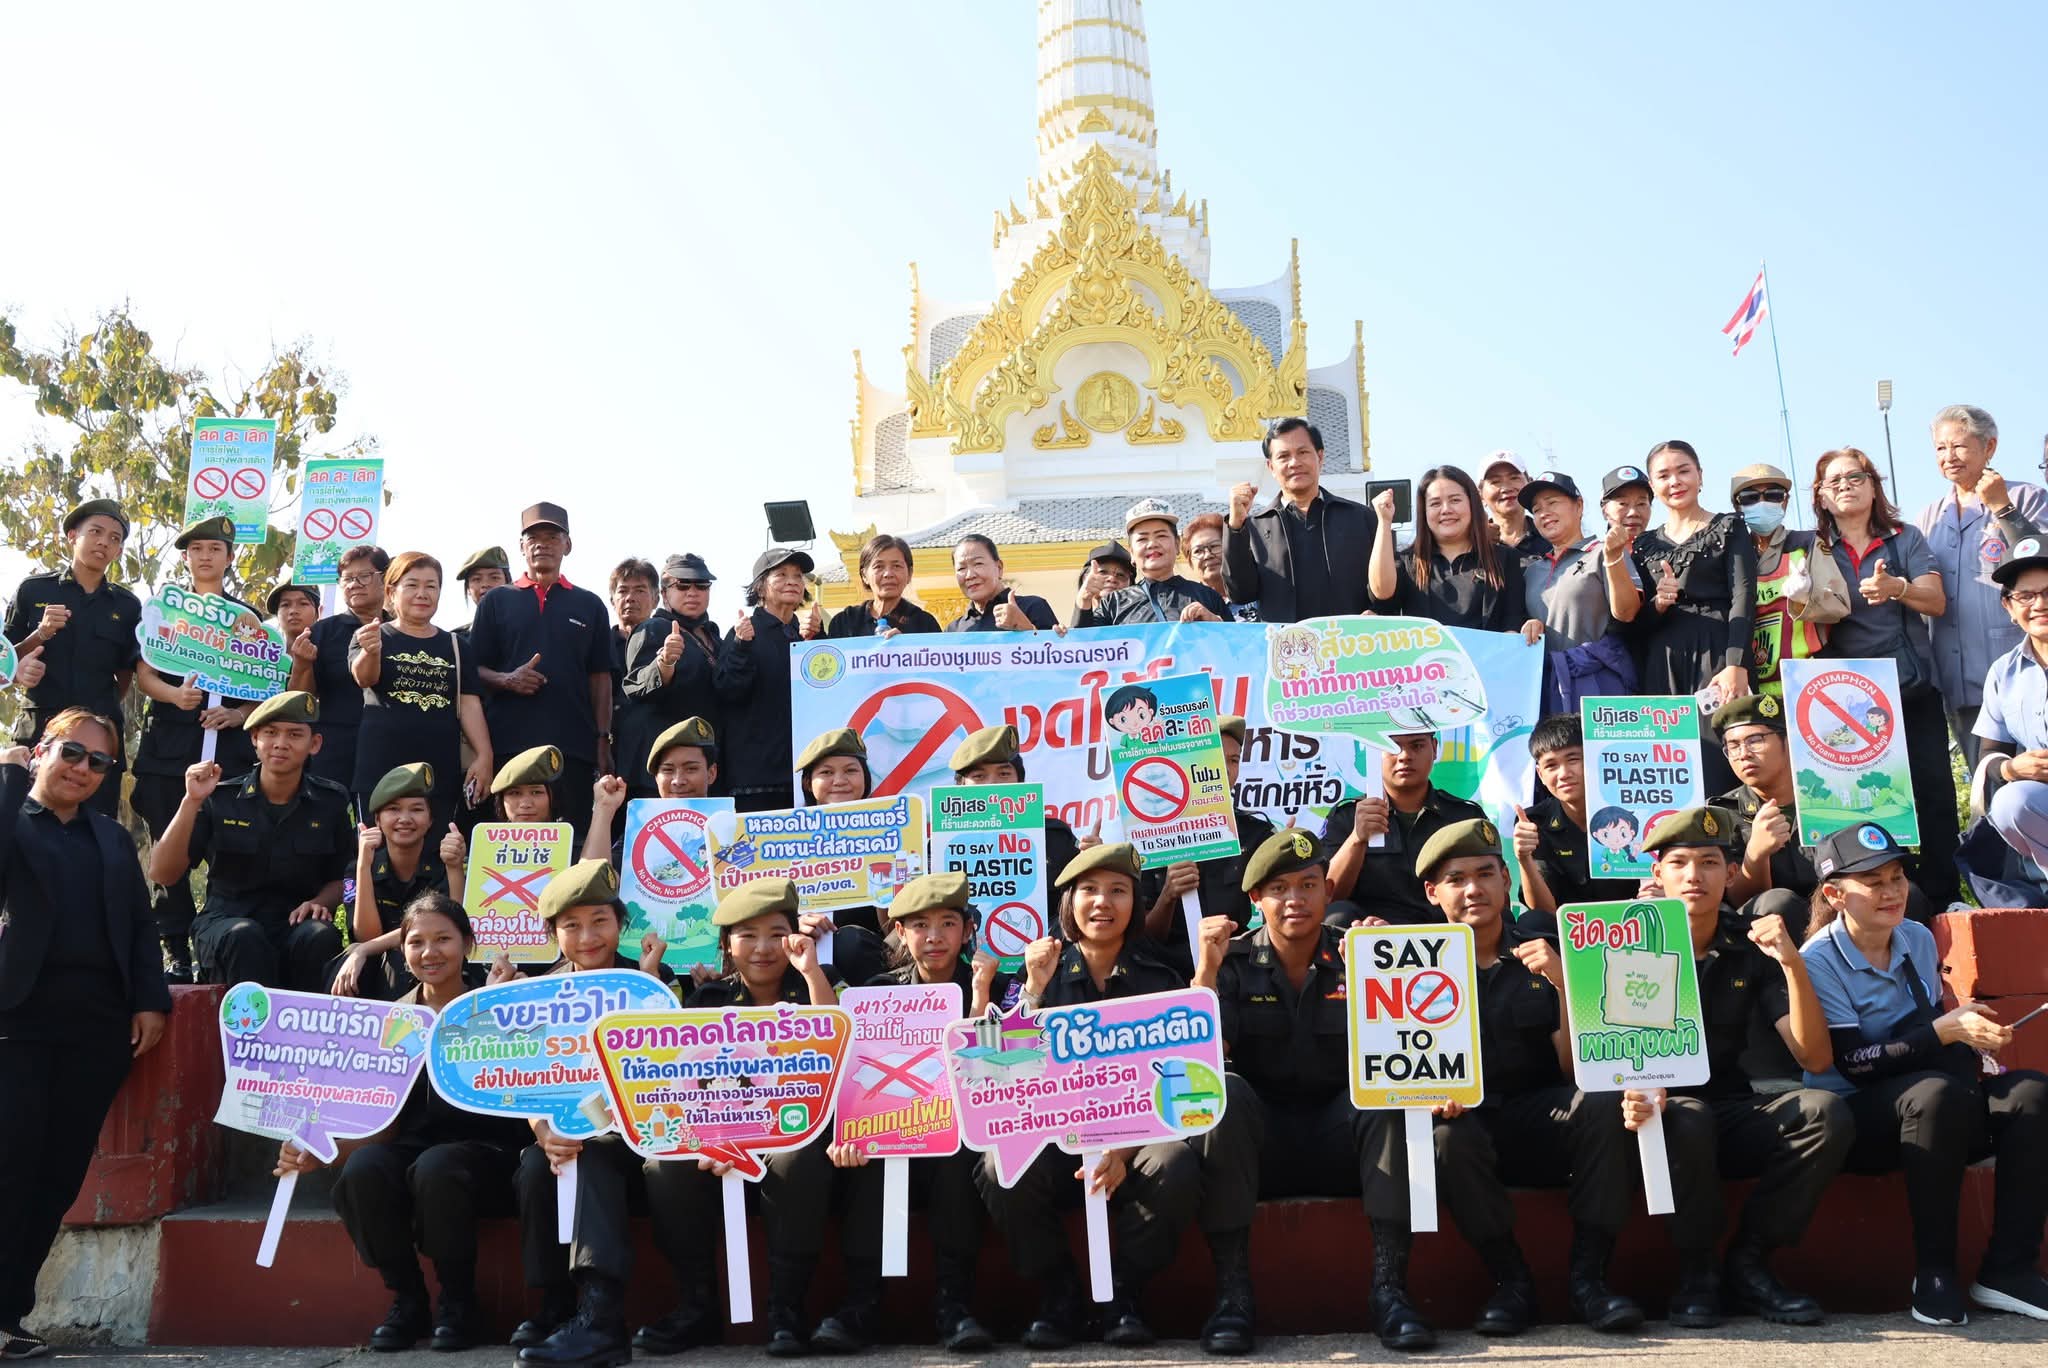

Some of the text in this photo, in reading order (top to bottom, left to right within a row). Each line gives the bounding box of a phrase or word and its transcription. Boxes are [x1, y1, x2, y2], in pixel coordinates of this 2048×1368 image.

[164, 588, 236, 627] ลดรับ
[175, 619, 228, 652] ลดให้
[230, 637, 282, 663] ลดใช้
[1319, 621, 1442, 660] สั่งอาหาร
[218, 655, 289, 684] พลาสติก
[851, 642, 1129, 672] เทศบาลเมืองชุมพร ร่วมใจรณรงค์
[1281, 662, 1446, 699] เท่าที่ทานหมด
[1806, 673, 1878, 697] CHUMPHON
[1159, 698, 1210, 716] ร่วมรณรงค์
[1272, 686, 1437, 724] ก็ช่วยลดโลกร้อนได้
[1593, 707, 1639, 728] ปฏิเสธ
[1141, 722, 1165, 744] ลด
[1187, 715, 1214, 736] เลิก
[1602, 743, 1687, 763] TO SAY No
[1806, 733, 1816, 746] No
[1839, 754, 1851, 763] No
[1851, 749, 1875, 763] Plastic
[1190, 764, 1221, 784] โฟม
[1603, 768, 1689, 785] PLASTIC
[940, 797, 986, 817] ปฏิเสธ
[1620, 789, 1674, 804] BAGS
[647, 812, 706, 832] CHUMPHO
[747, 797, 908, 834] หลอดไฟ แบตเตอรี่
[487, 828, 559, 847] ขอบคุณ
[762, 830, 899, 859] ภาชนะใส่สารเคมี
[948, 833, 1031, 855] TO SAY No
[1141, 830, 1222, 851] To Say No Foam
[496, 844, 551, 864] ที่ ไม่ ใช้
[638, 868, 646, 880] No
[665, 886, 675, 896] No
[468, 909, 545, 933] กล่องโฟ
[474, 932, 549, 950] บรรจุอาหาร
[1373, 938, 1446, 970] SAY
[853, 990, 948, 1015] มาร่วมกัน
[1625, 980, 1660, 1000] ECO
[277, 999, 380, 1039] คนน่ารัก
[606, 1009, 834, 1050] อยากลดโลกร้อน
[446, 1034, 540, 1062] ทำให้แห้ง
[1052, 1010, 1209, 1059] ใช้พลาสติก
[1397, 1029, 1433, 1050] TO
[1579, 1018, 1700, 1071] พกถุงผ้า
[234, 1033, 409, 1076] มักพกถุงผ้า/ตะกร้า
[621, 1047, 832, 1081] ให้ลดการทิ้งพลาสติก
[1365, 1053, 1466, 1081] FOAM
[236, 1076, 396, 1108] แทนการรับถุงพลาสติก
[635, 1083, 821, 1105] แต่ถ้าอยากเจอพรหมลิขิต
[971, 1064, 1138, 1107] อย่างรู้คิด เพื่อชีวิต
[684, 1106, 772, 1126] ให้ไลน์หาเรา
[843, 1096, 953, 1142] ทดแทนโฟม
[988, 1088, 1152, 1136] และสิ่งแวดล้อมที่ดี
[900, 1119, 952, 1140] บรรจุอาหาร
